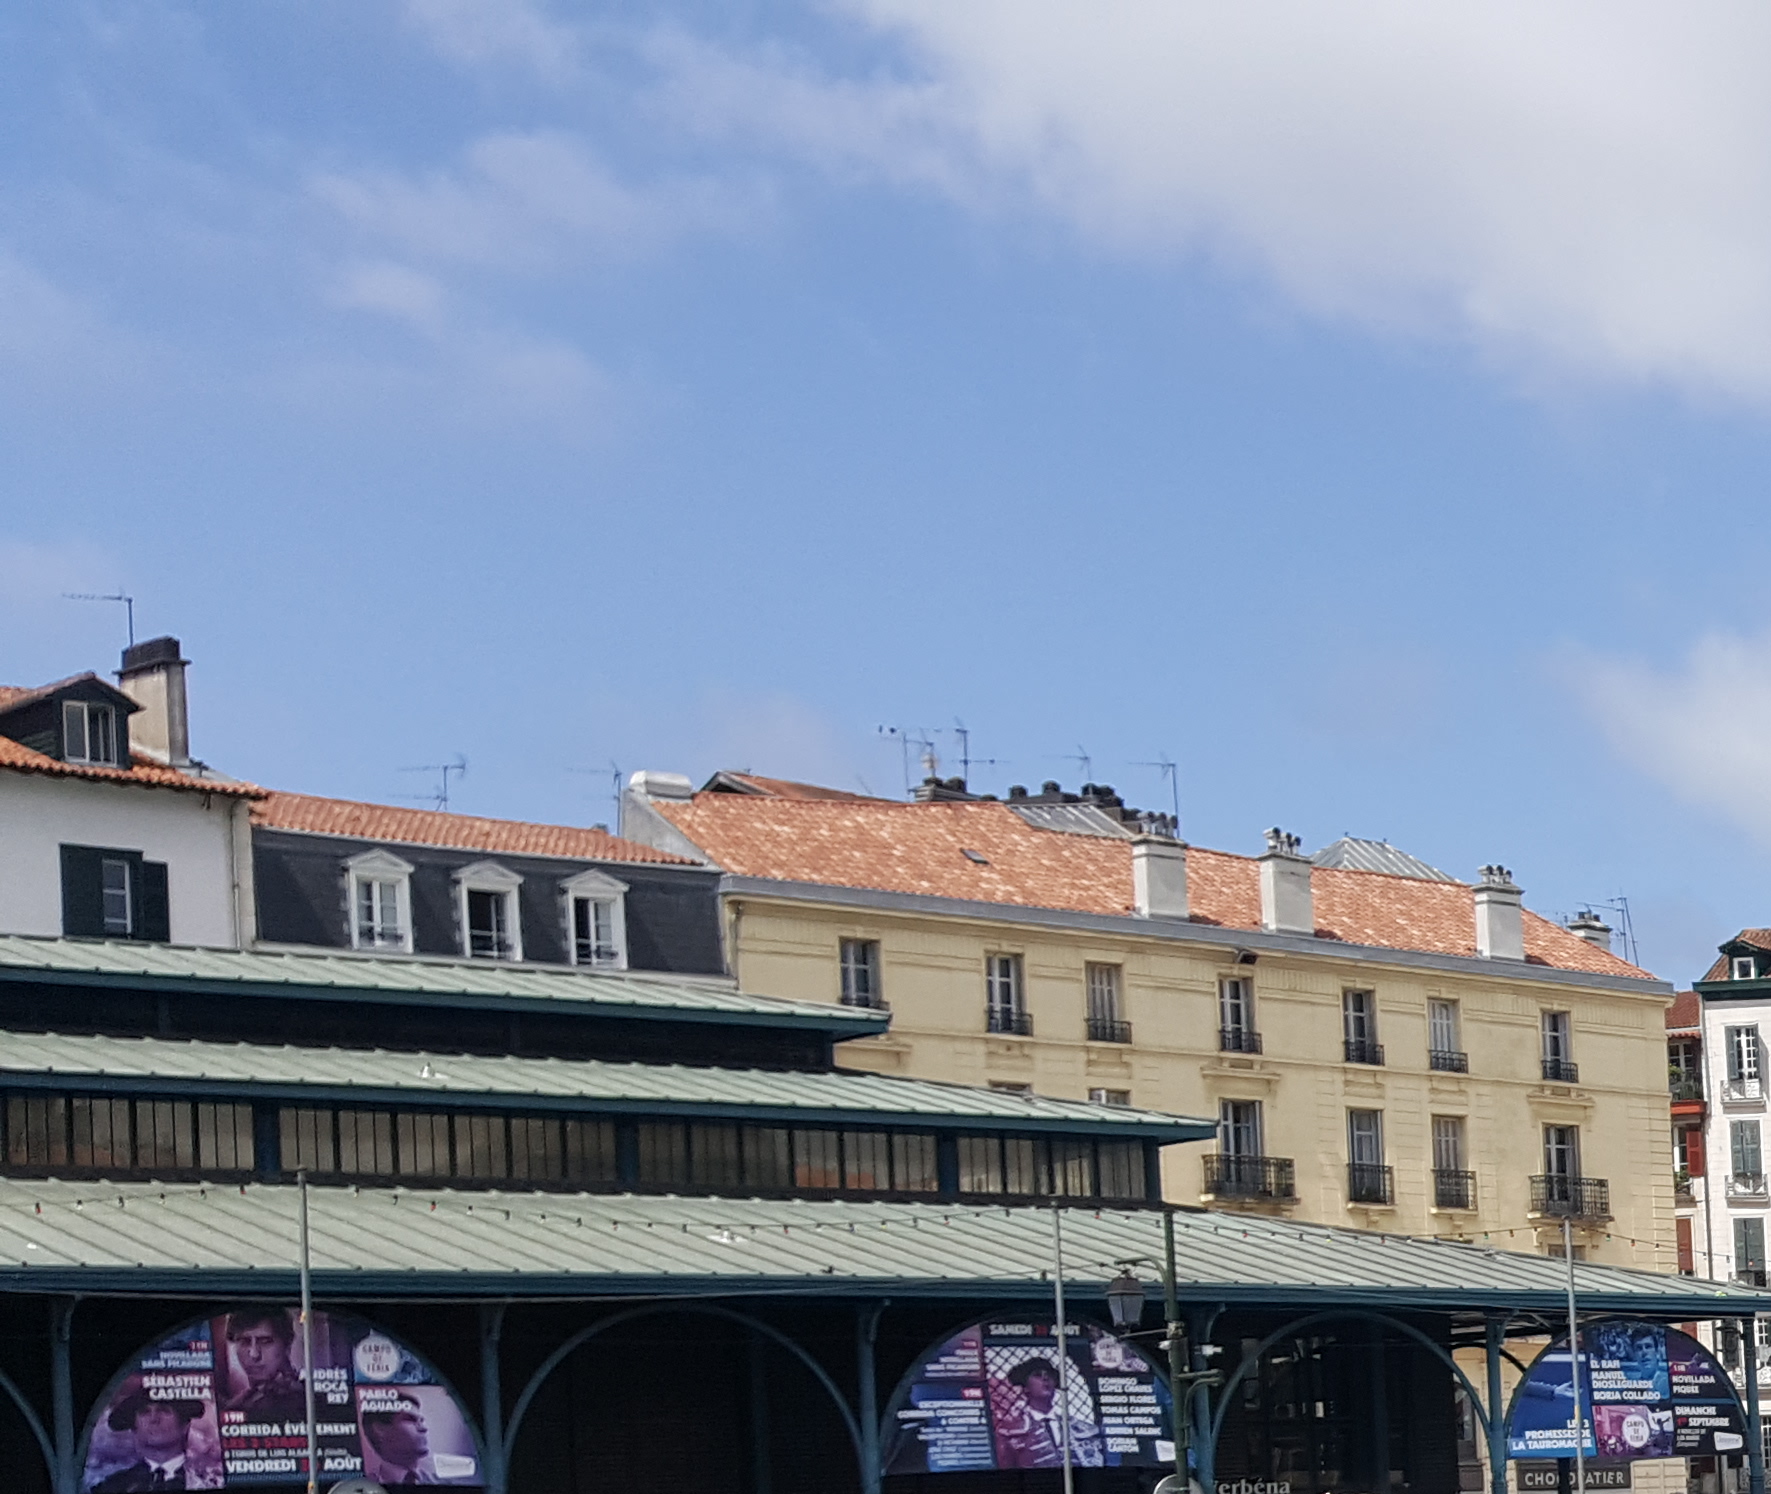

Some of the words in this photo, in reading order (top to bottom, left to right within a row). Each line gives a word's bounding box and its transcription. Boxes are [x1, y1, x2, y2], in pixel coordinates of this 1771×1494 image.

[299, 1366, 348, 1380] ADRÉS
[1672, 1375, 1715, 1383] NOVILLADA
[142, 1373, 211, 1388] SÉBASTIEN
[314, 1381, 348, 1392] ROCA
[149, 1387, 212, 1400] CASTELLA
[327, 1392, 349, 1404] REY
[359, 1388, 399, 1399] PABLO
[1622, 1391, 1661, 1400] COLLADO
[361, 1400, 412, 1413] AGUADO
[1675, 1406, 1717, 1415] DIMANCHE
[221, 1423, 282, 1436] CORRIDA
[1567, 1419, 1579, 1429] LE
[1512, 1441, 1526, 1451] LA
[1527, 1439, 1593, 1450] TAUROMACIE
[225, 1459, 297, 1473] VENDREDI
[323, 1454, 362, 1470] AOÛT
[1525, 1471, 1625, 1486] CHOOATIER
